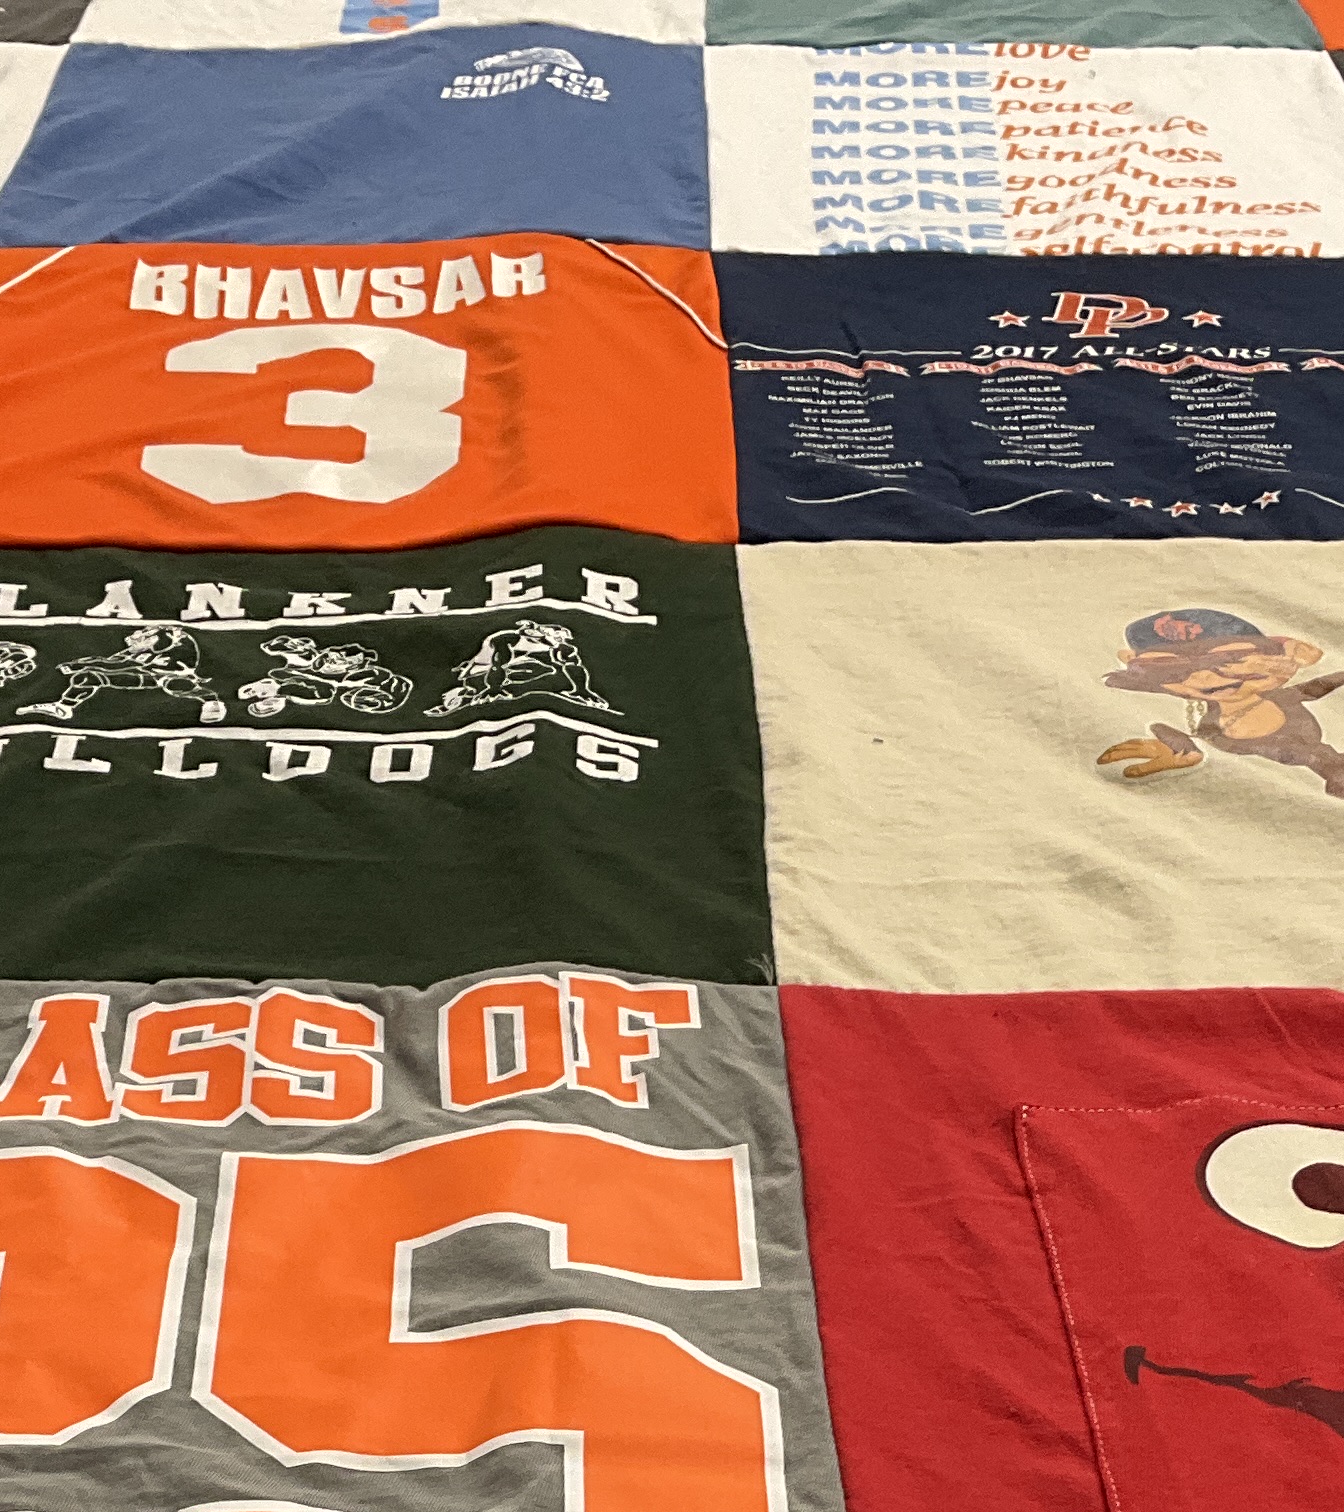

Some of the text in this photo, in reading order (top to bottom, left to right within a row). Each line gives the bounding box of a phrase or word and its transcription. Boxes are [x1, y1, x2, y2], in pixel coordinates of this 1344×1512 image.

[994, 42, 1091, 62] love
[554, 66, 605, 90] FCA
[813, 70, 1067, 94] MORE joy
[813, 95, 1134, 116] MORE peace
[812, 116, 1209, 140] MORE patience
[811, 141, 1223, 163] MORE kindness
[811, 157, 1237, 191] MORE goodness
[812, 182, 1322, 218] MORE faithfulness
[129, 252, 546, 319] BHAVSAR
[972, 341, 1272, 360] 2017 ALL-STARS
[140, 323, 467, 504] 3
[438, 968, 701, 1112] OF
